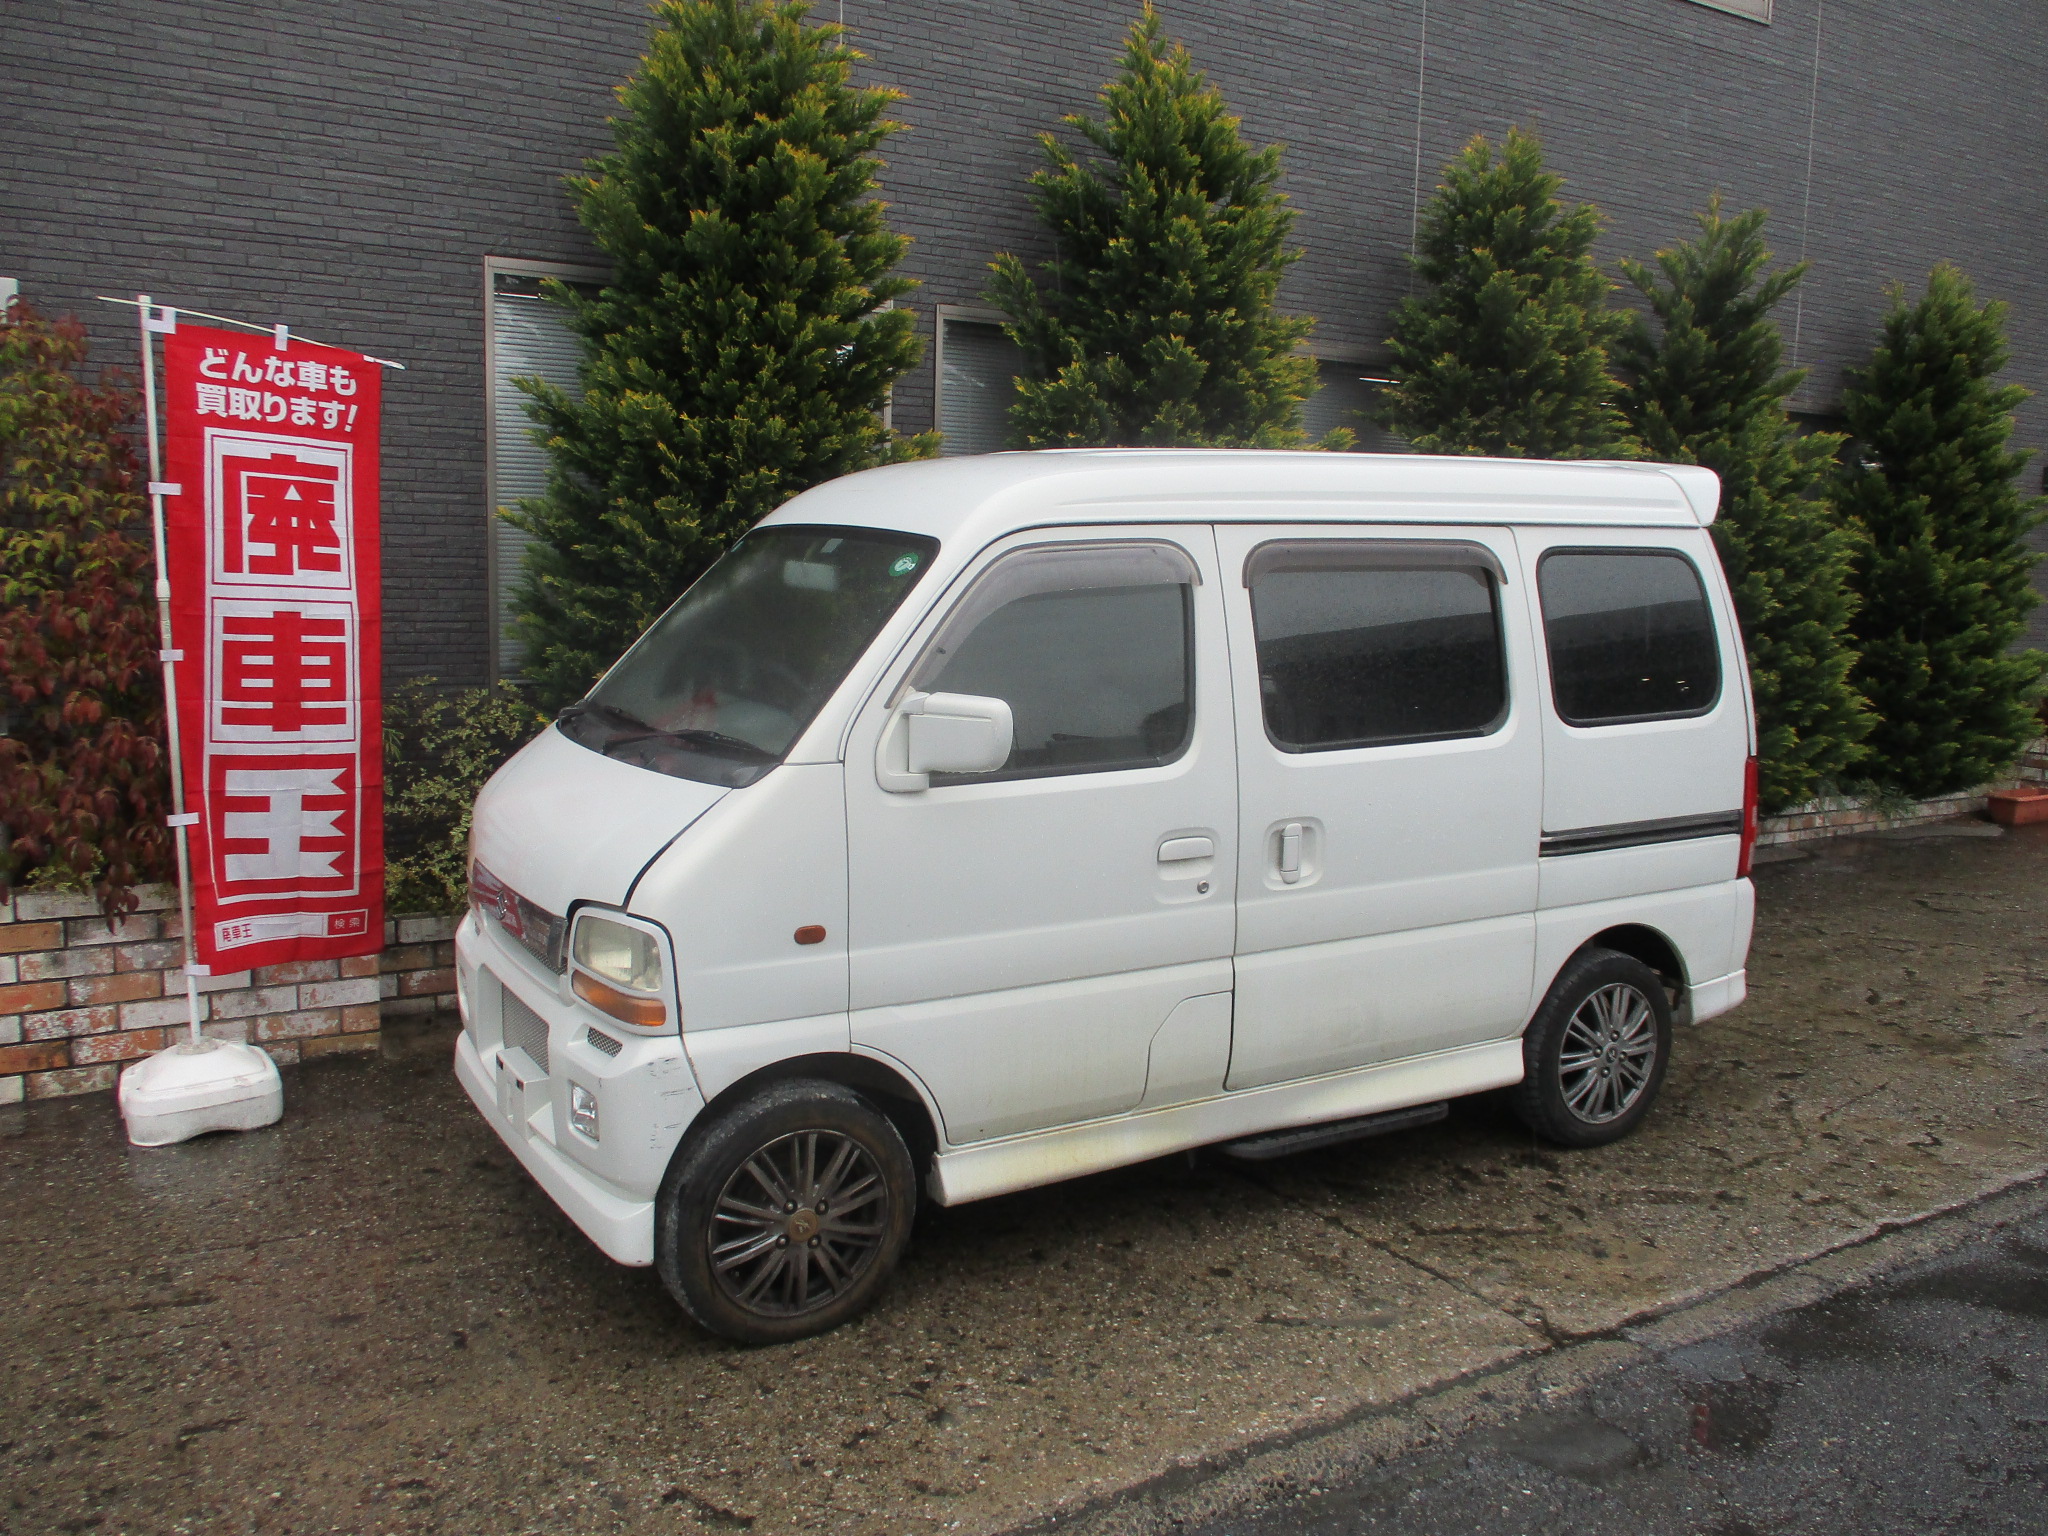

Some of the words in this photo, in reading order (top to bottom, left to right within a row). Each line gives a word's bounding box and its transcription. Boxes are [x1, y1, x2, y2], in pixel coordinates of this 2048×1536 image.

[199, 347, 357, 396] どんな車も
[195, 382, 358, 432] 買取ります!
[222, 452, 347, 882] 廃車王
